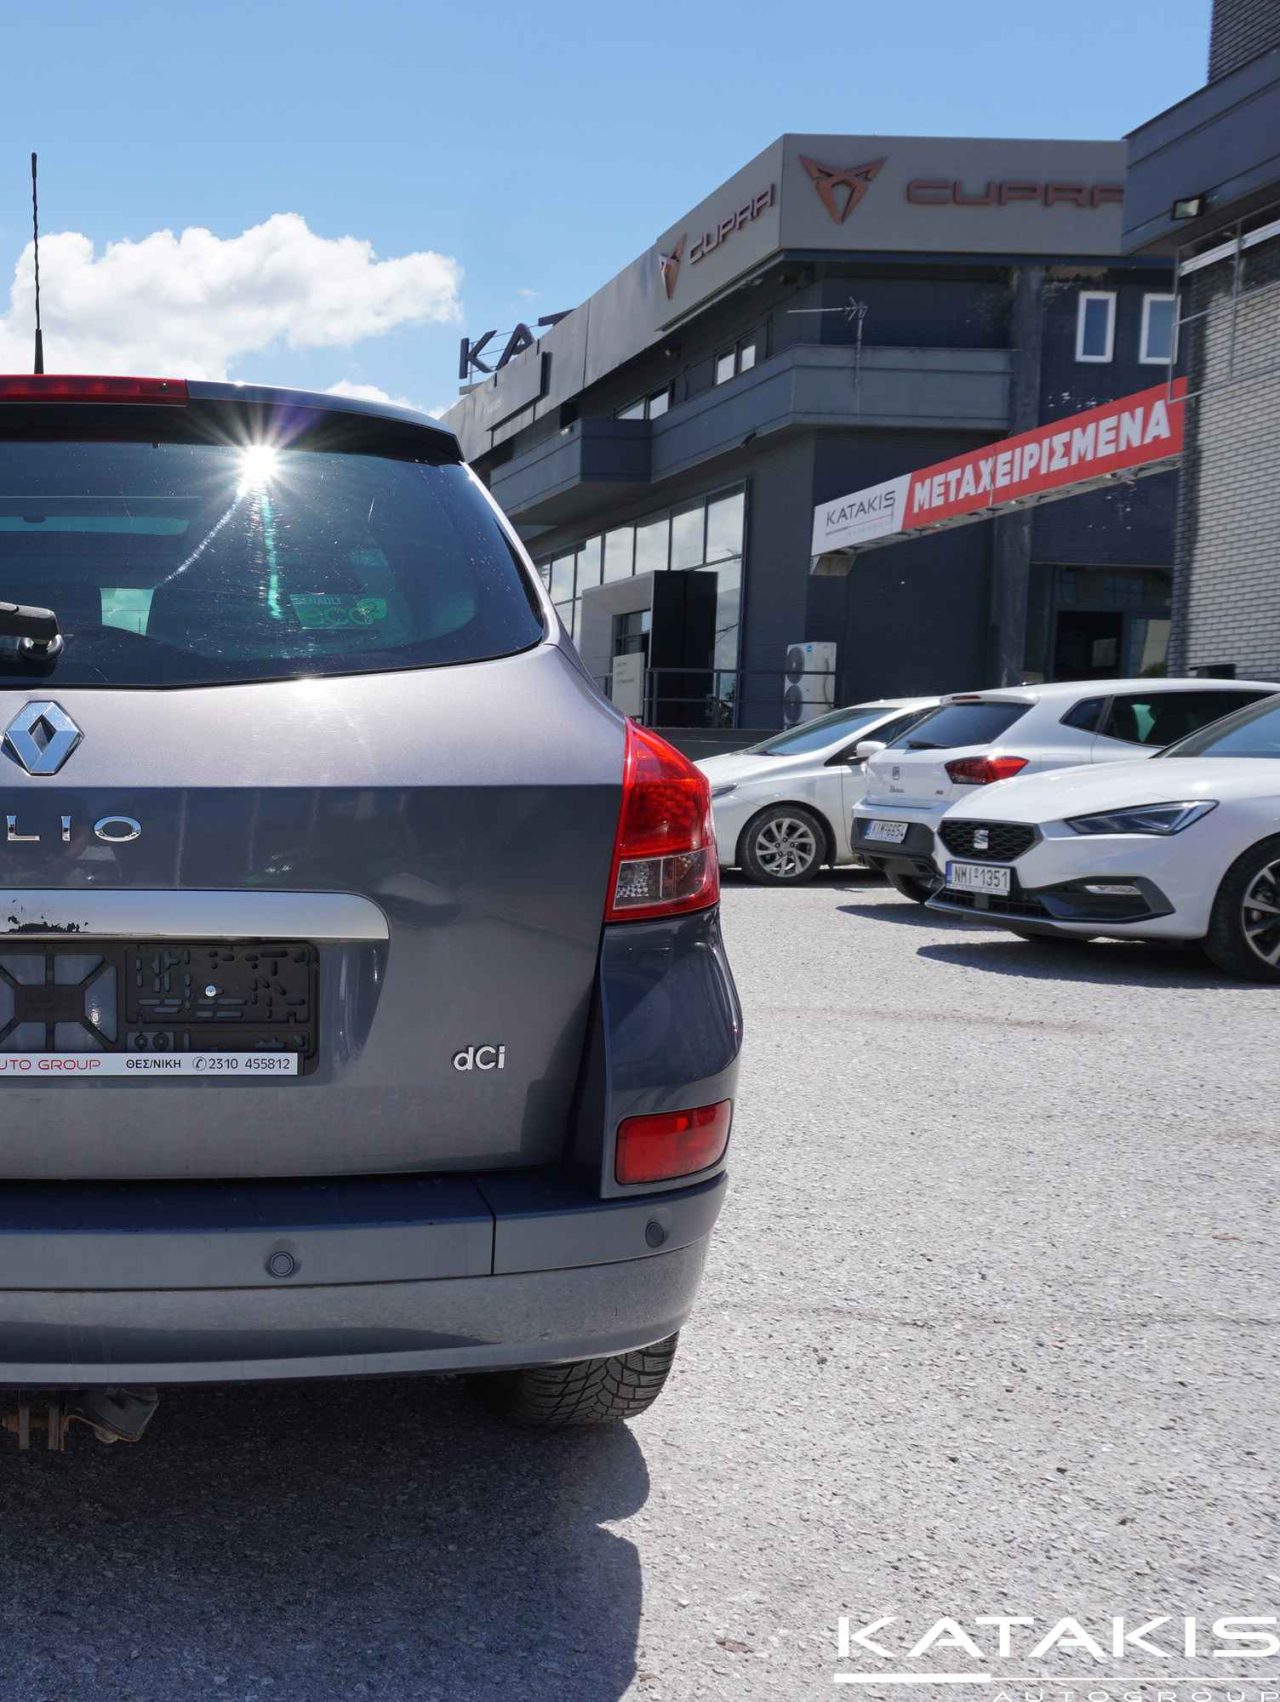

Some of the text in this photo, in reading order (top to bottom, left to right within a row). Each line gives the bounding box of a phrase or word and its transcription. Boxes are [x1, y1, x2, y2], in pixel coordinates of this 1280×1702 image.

[689, 183, 776, 264] CUPRA
[913, 399, 1171, 513] ΜΕΤΑΧΕΙΡΙΣΜΕΝΑ
[826, 490, 896, 527] KATAKIS
[38, 1059, 101, 1071] GROUP
[208, 1058, 239, 1070] 2310
[244, 1058, 291, 1070] 455812
[452, 1045, 506, 1071] dCi
